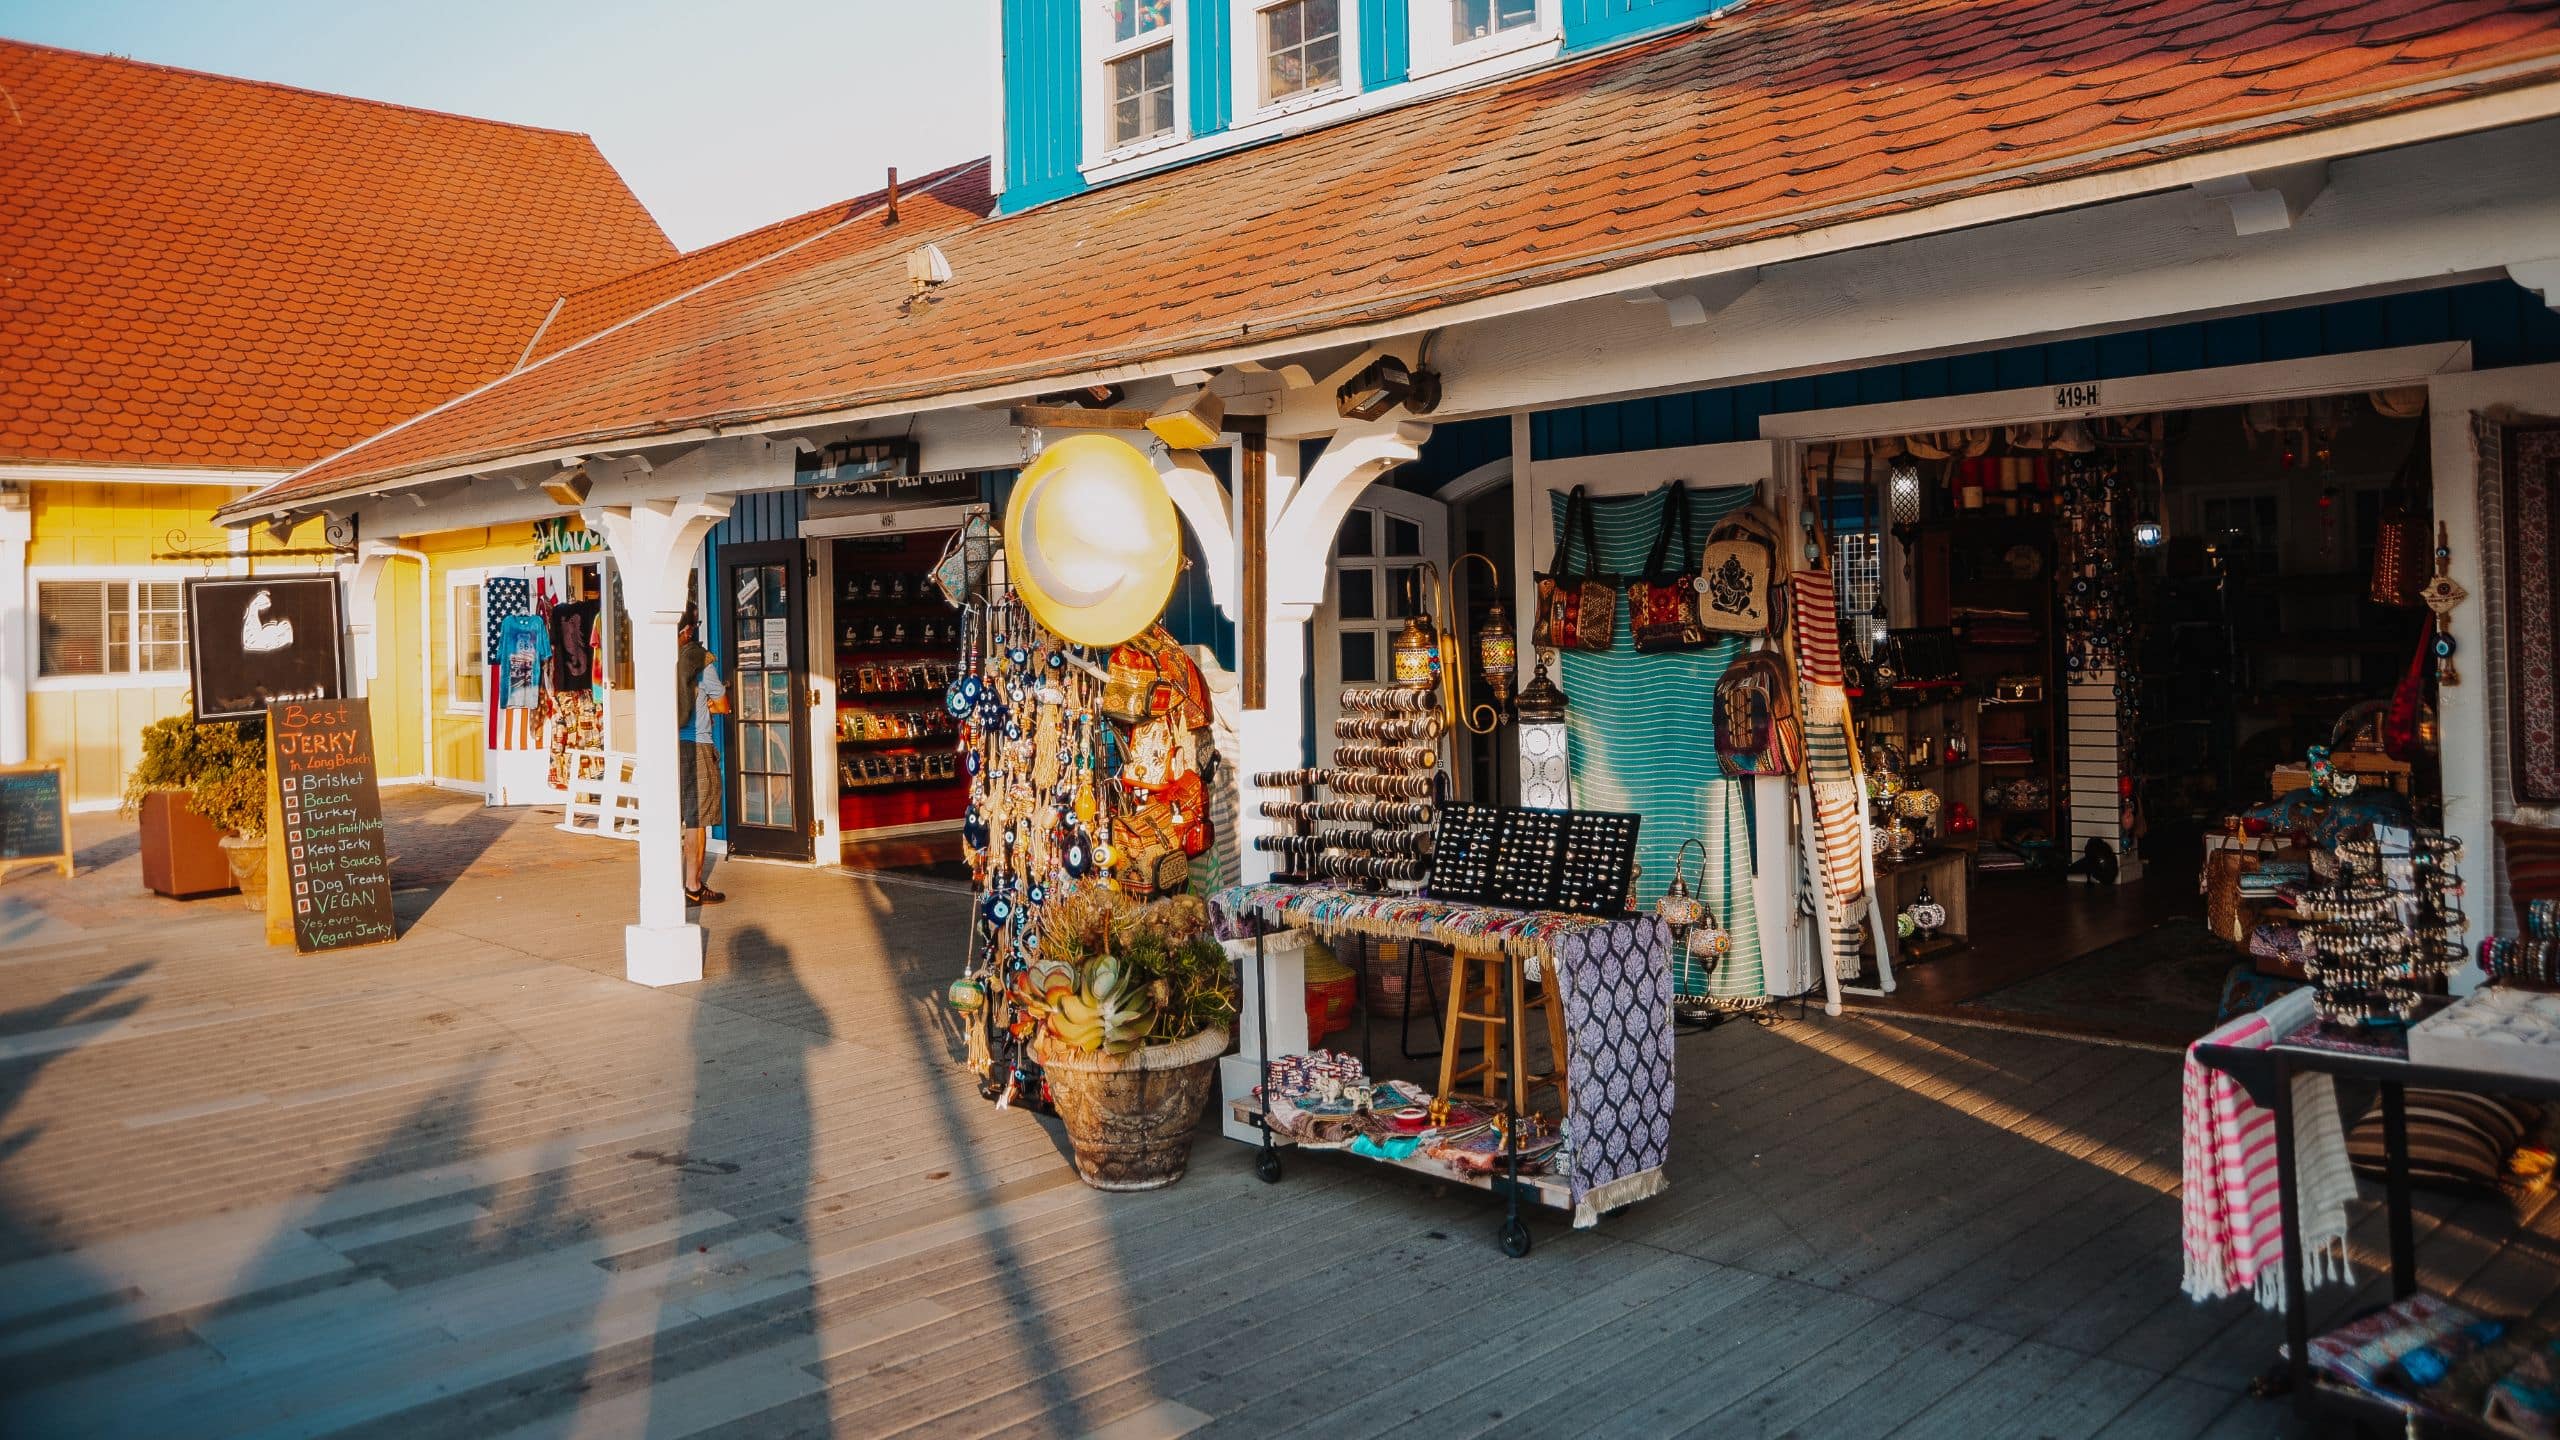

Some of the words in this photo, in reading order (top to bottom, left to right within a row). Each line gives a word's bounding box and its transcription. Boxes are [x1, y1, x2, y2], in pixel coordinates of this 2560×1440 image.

[2058, 385, 2097, 408] 419-H
[282, 704, 348, 728] Best
[279, 729, 357, 754] JERKY
[290, 759, 303, 772] in
[302, 771, 364, 790] Brisket
[304, 792, 352, 808] Bacon
[303, 807, 357, 822] Turkey
[305, 826, 336, 840] Dried
[307, 843, 336, 857] Keto
[338, 839, 371, 851] Jerky
[309, 859, 335, 874] Hot
[340, 855, 382, 869] Sauces
[313, 879, 344, 893] Dog
[345, 872, 385, 886] Treats
[314, 889, 375, 914] VEGAN
[309, 929, 353, 948] Vegan
[355, 921, 393, 937] Jerky
